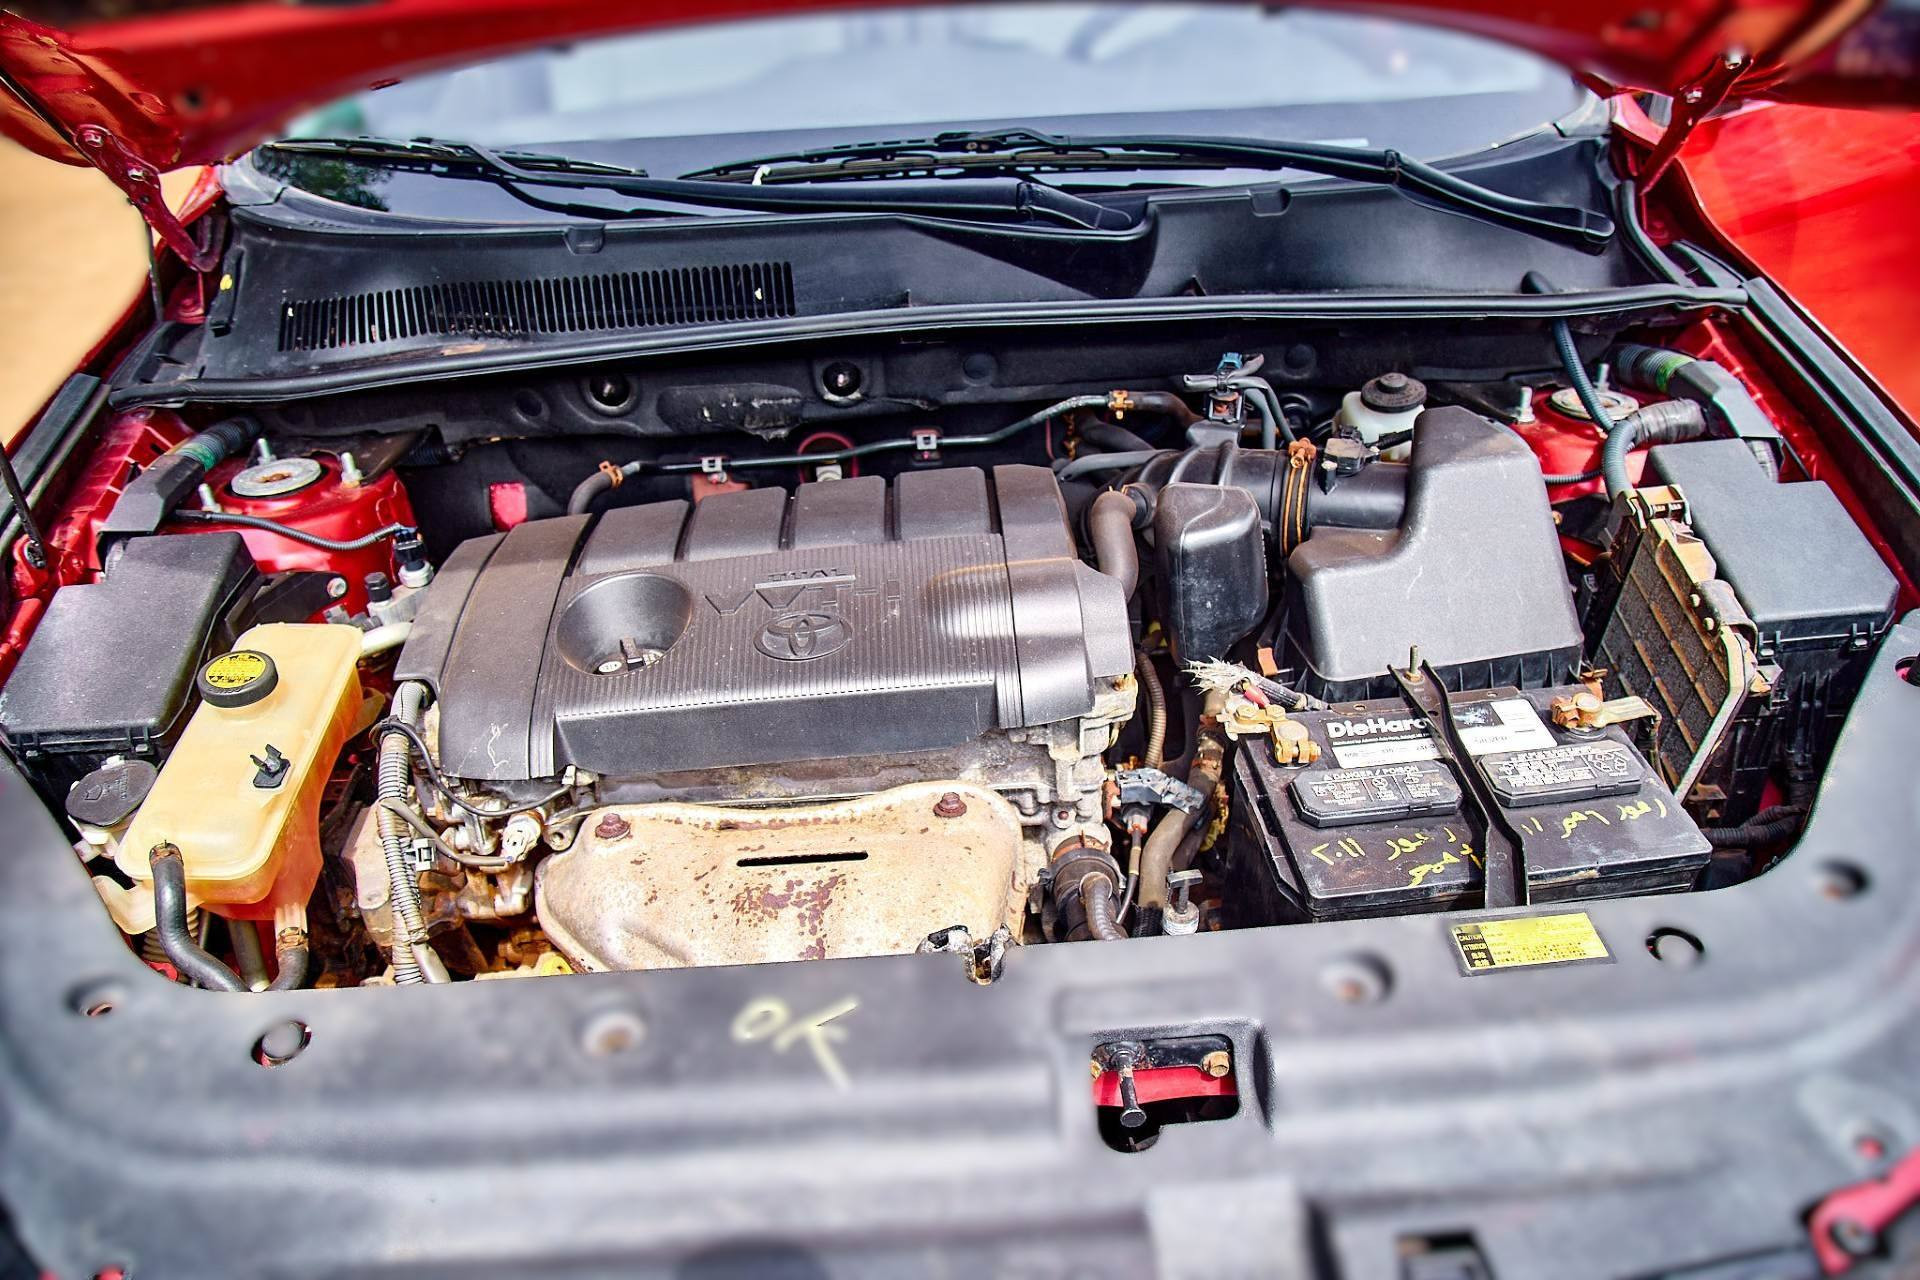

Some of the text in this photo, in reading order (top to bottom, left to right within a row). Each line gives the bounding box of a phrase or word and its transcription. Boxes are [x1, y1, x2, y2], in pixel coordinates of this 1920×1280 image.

[1332, 770, 1374, 781] DANGER
[1383, 766, 1420, 776] POISON
[1458, 934, 1483, 942] CAUTION
[730, 994, 861, 1094] OK
